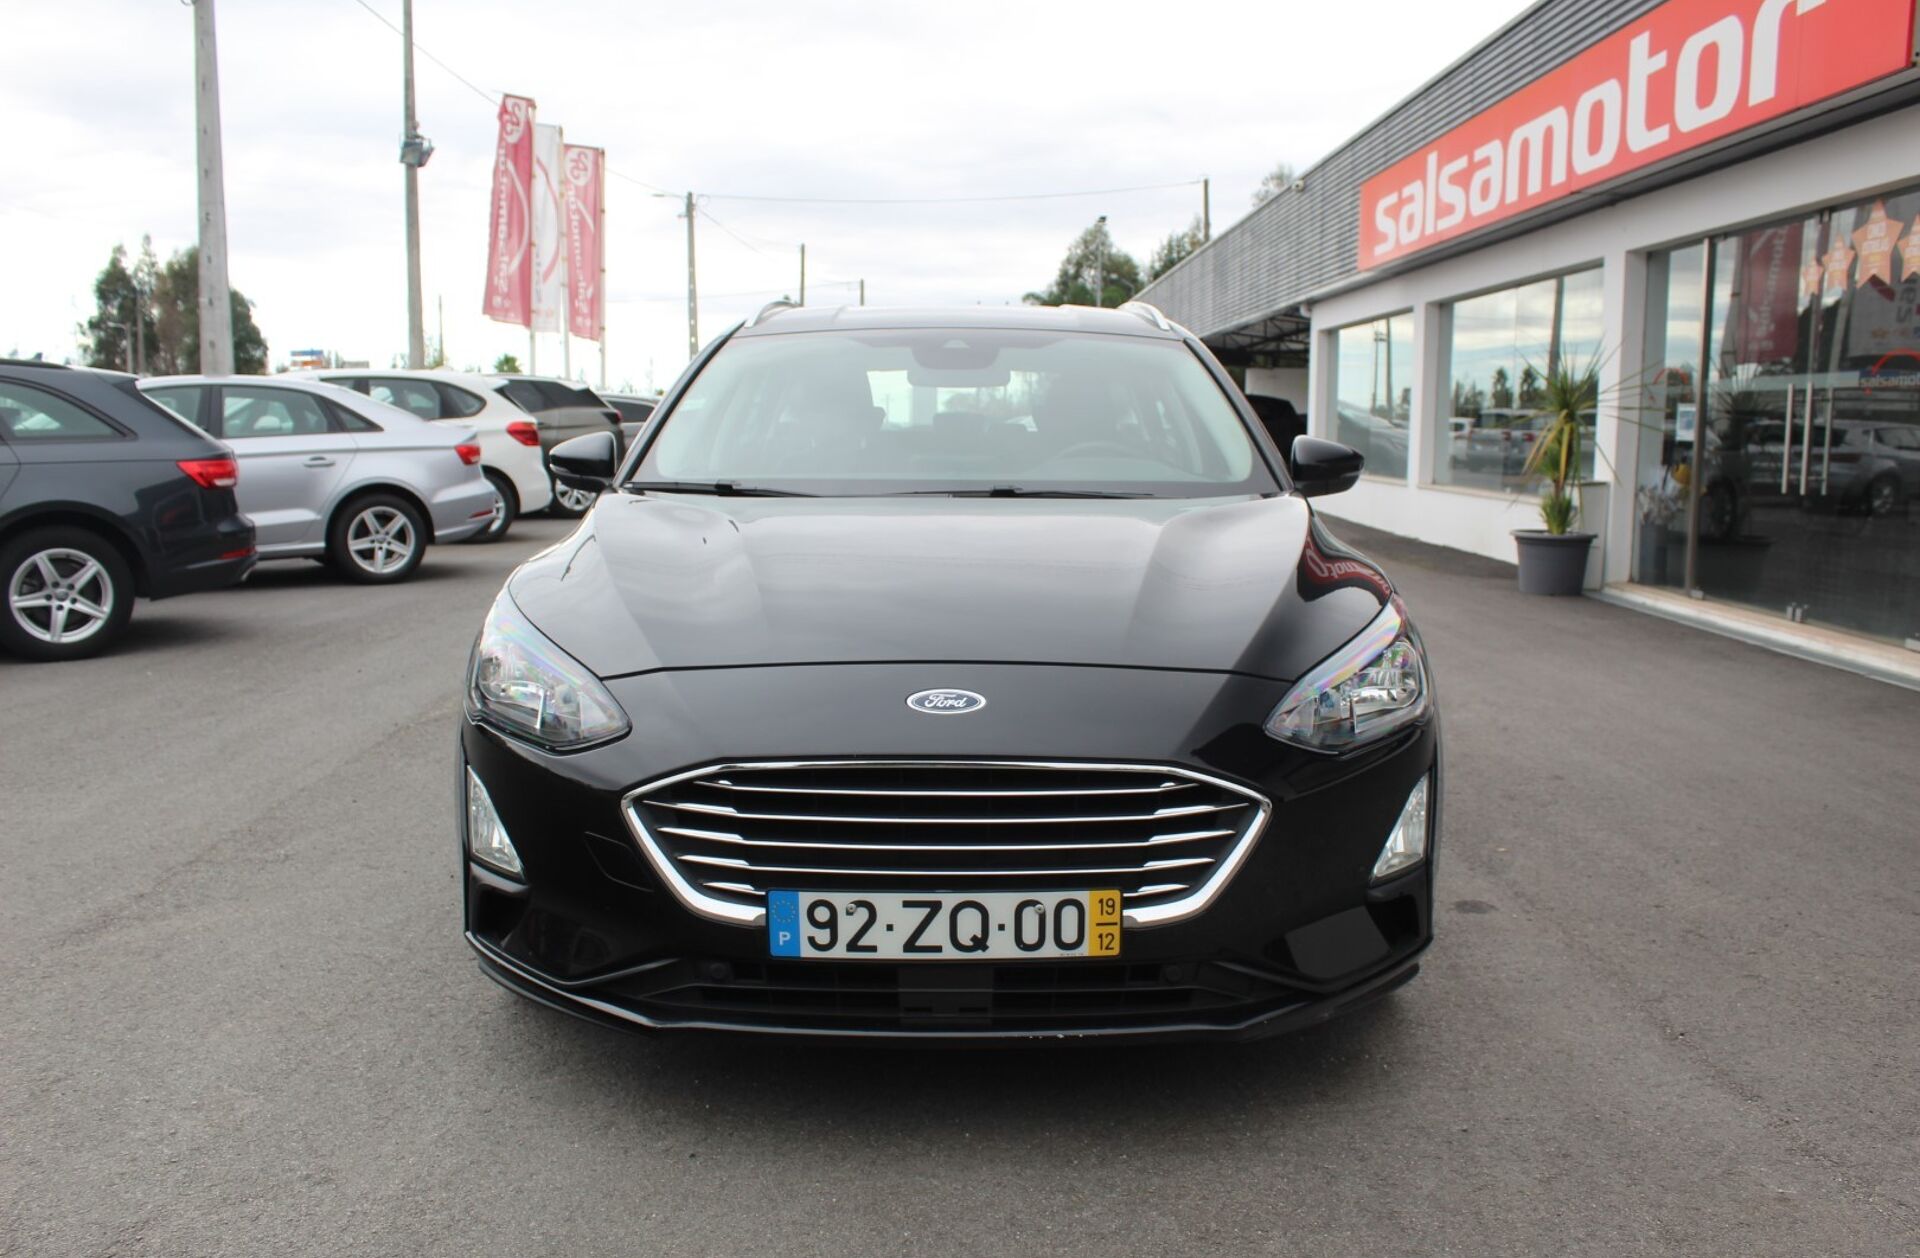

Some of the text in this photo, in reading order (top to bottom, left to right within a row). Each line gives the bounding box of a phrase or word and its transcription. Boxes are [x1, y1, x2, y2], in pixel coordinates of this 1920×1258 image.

[1374, 0, 1826, 256] salsamotor
[924, 693, 967, 708] Ford
[1098, 898, 1115, 916] 19
[779, 932, 790, 946] P
[1098, 933, 1115, 951] 12
